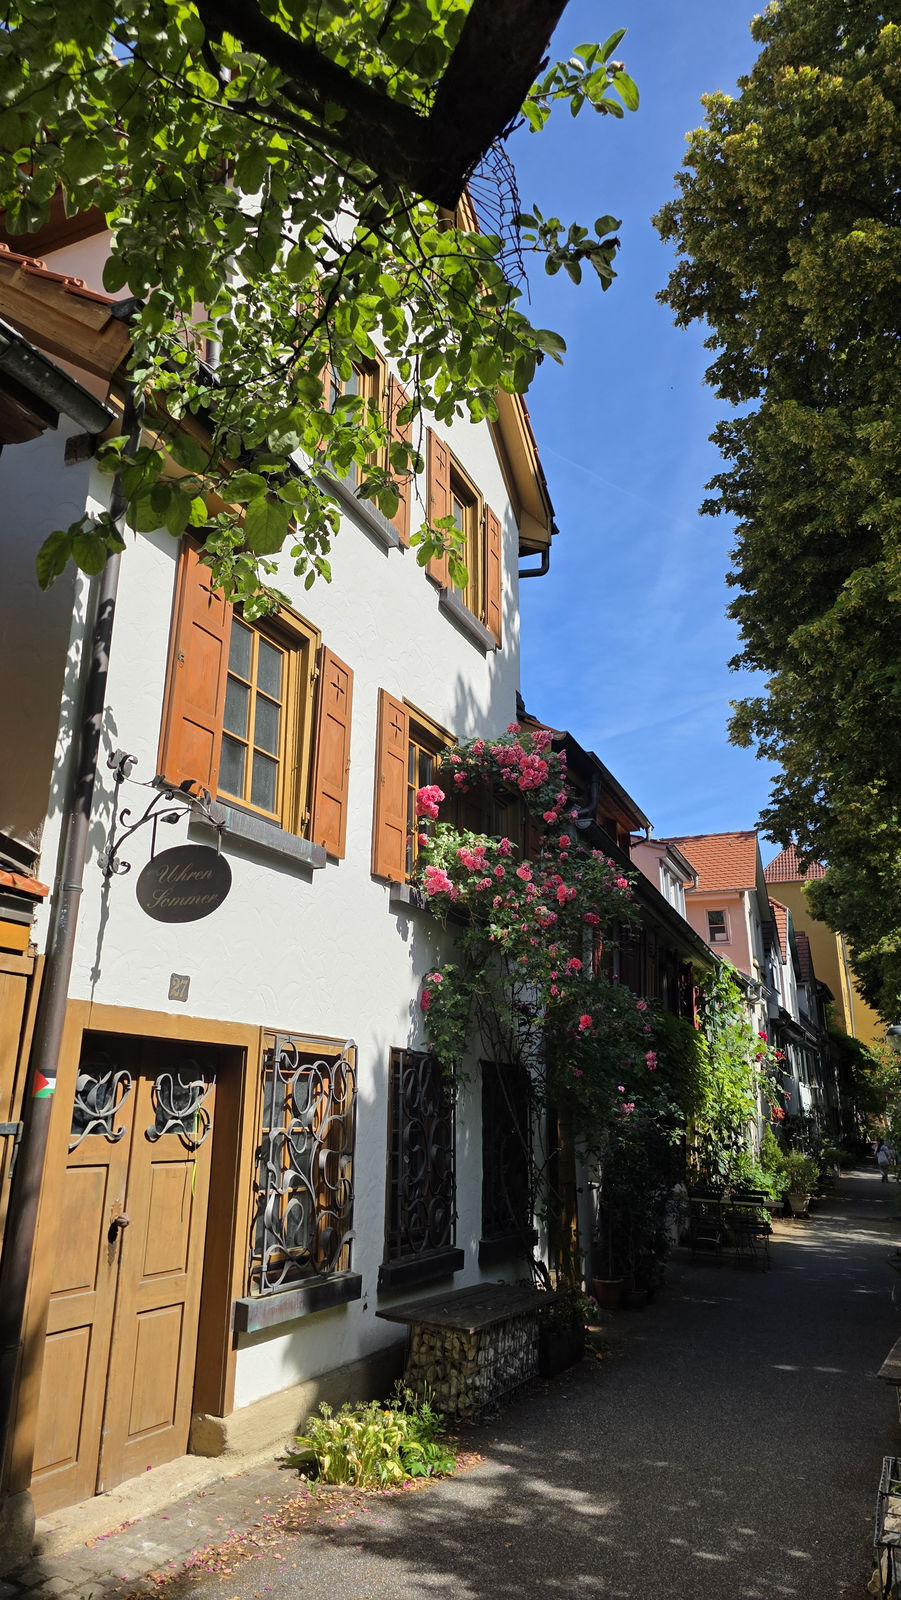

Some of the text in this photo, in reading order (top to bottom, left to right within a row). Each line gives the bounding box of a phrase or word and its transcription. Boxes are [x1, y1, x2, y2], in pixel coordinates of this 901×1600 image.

[157, 863, 212, 884] Uhren
[147, 887, 219, 909] Sommer
[172, 978, 187, 998] 27
